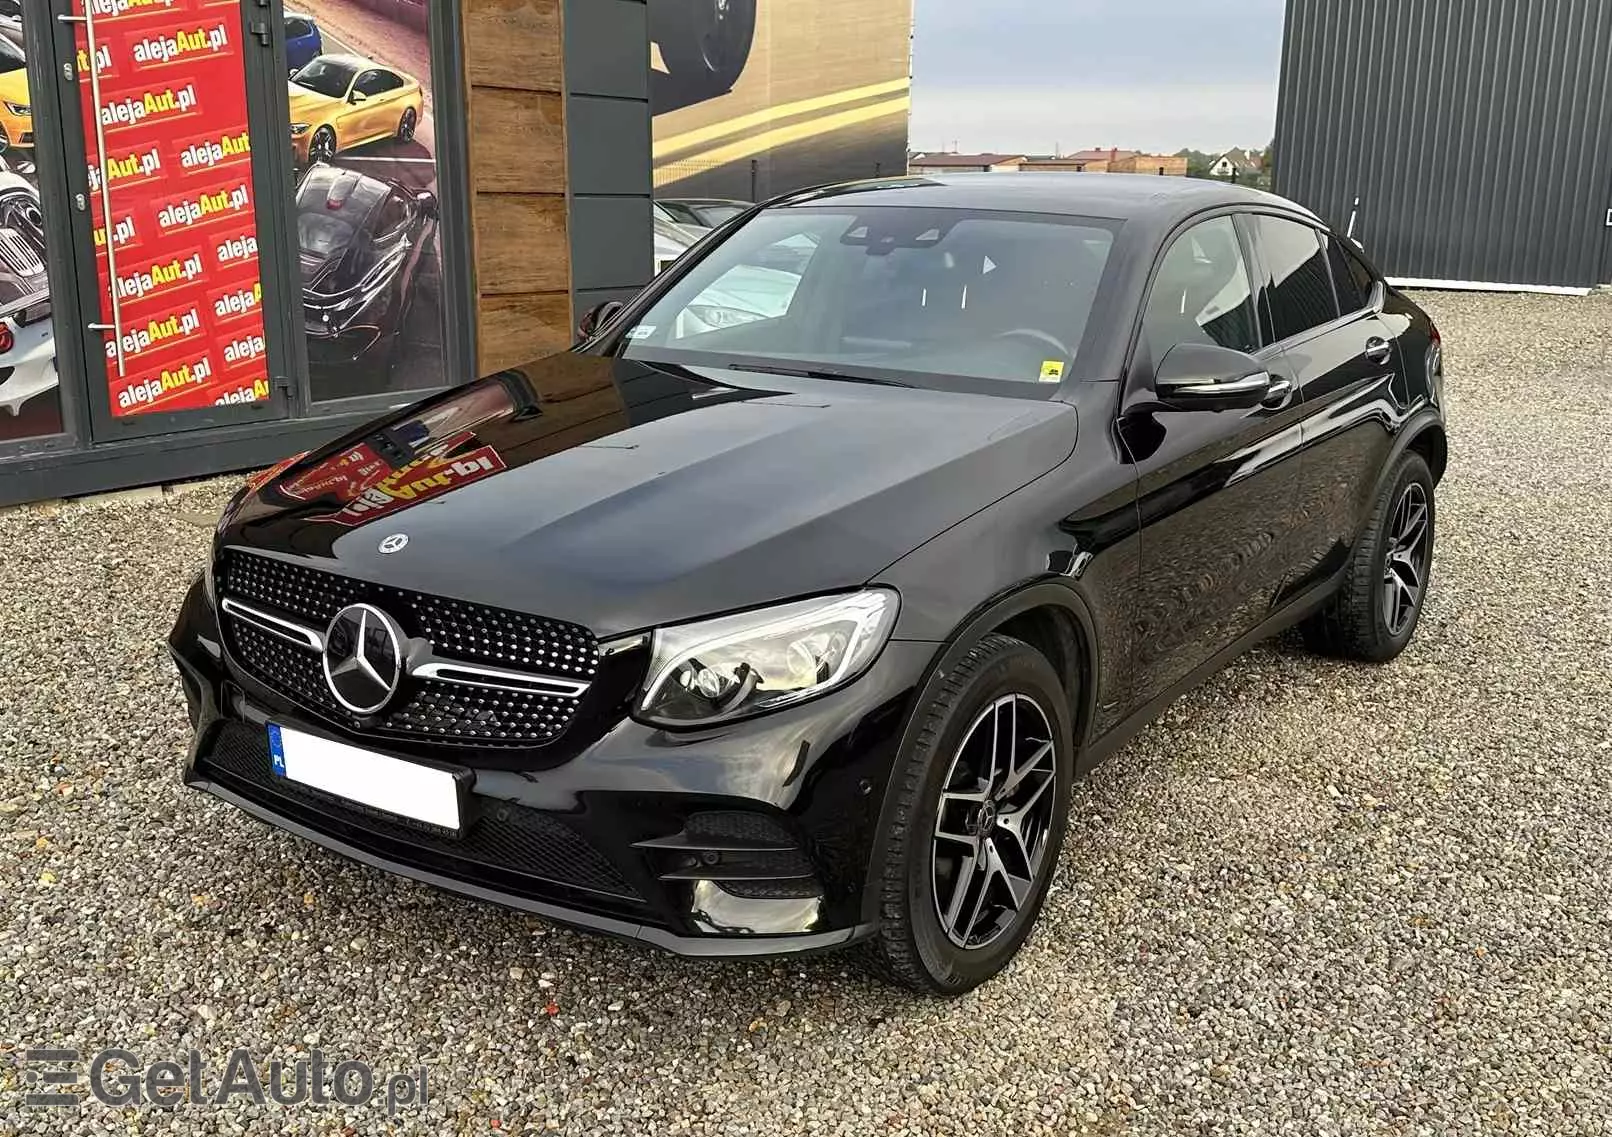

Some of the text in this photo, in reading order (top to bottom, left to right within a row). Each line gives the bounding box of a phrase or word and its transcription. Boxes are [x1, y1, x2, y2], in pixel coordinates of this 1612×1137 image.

[133, 24, 228, 62] alejaAut.pl
[101, 84, 197, 125] alejaAut.pl
[180, 130, 250, 167] alejaAut
[158, 184, 249, 228] alejaAut.pl
[93, 216, 136, 246] u.pl
[217, 235, 258, 262] aleja
[108, 253, 203, 299] lejaAut.pl
[105, 308, 200, 358] aejaAut.pl
[118, 356, 211, 408] alejaAut.pl
[273, 754, 285, 769] PL
